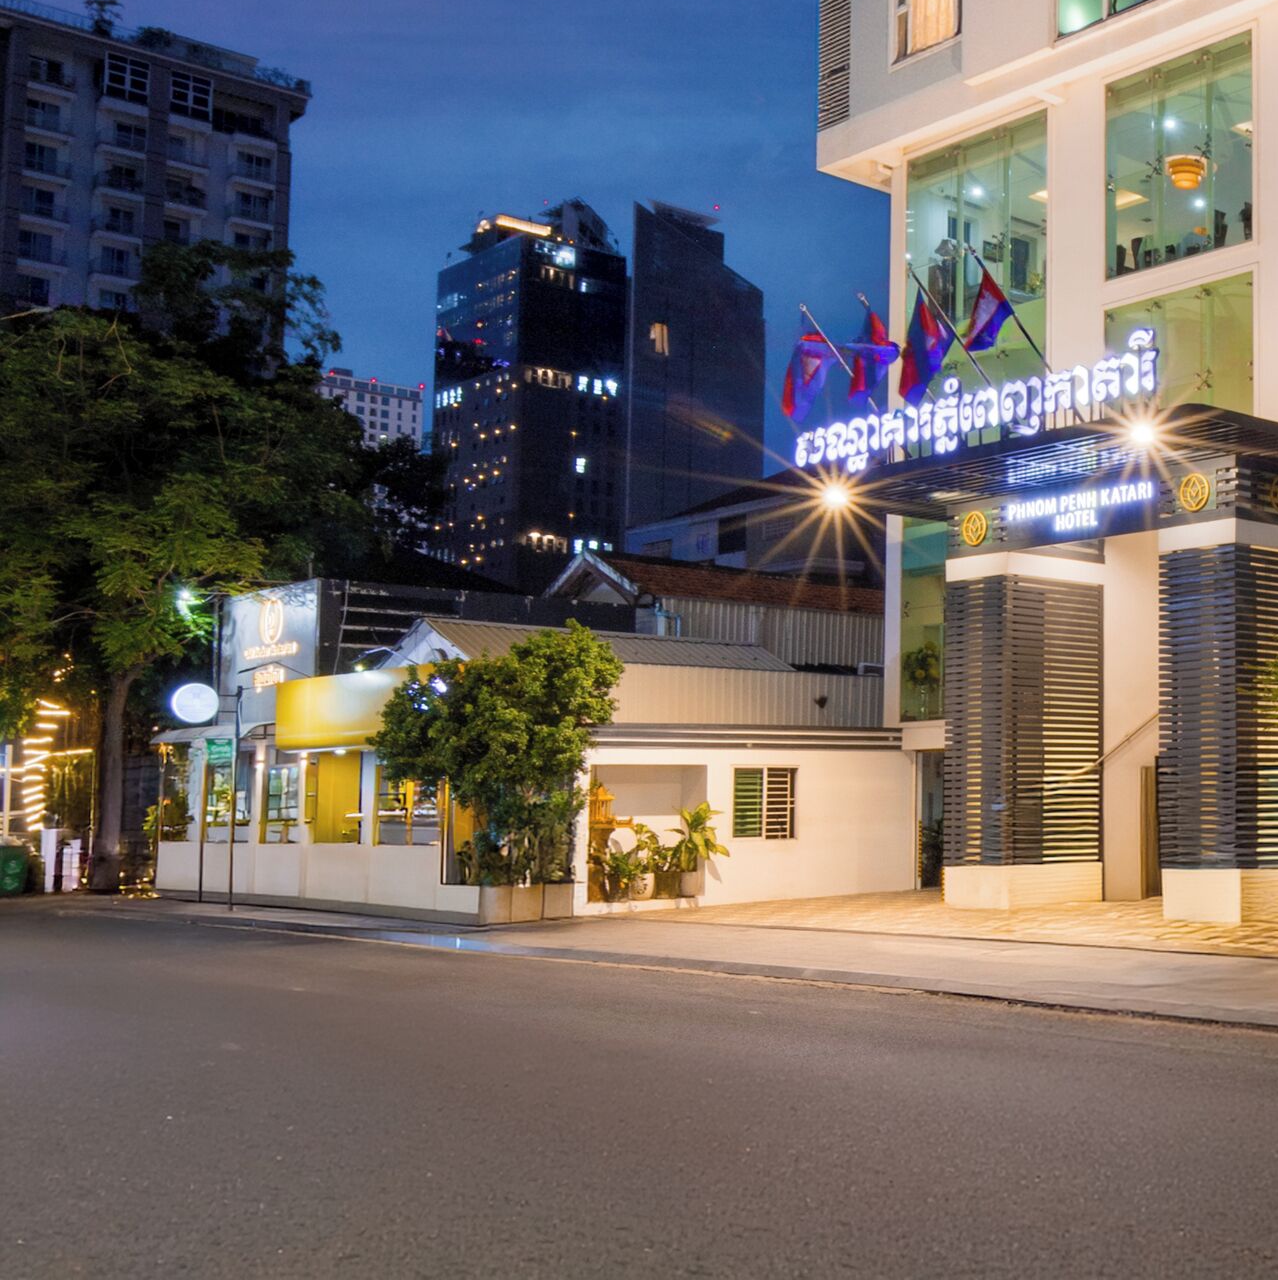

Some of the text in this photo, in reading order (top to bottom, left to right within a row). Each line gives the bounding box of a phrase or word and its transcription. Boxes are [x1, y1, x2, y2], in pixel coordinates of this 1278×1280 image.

[1008, 481, 1153, 521] PHNOM PENH KATARI
[1055, 509, 1098, 532] HOTEL
